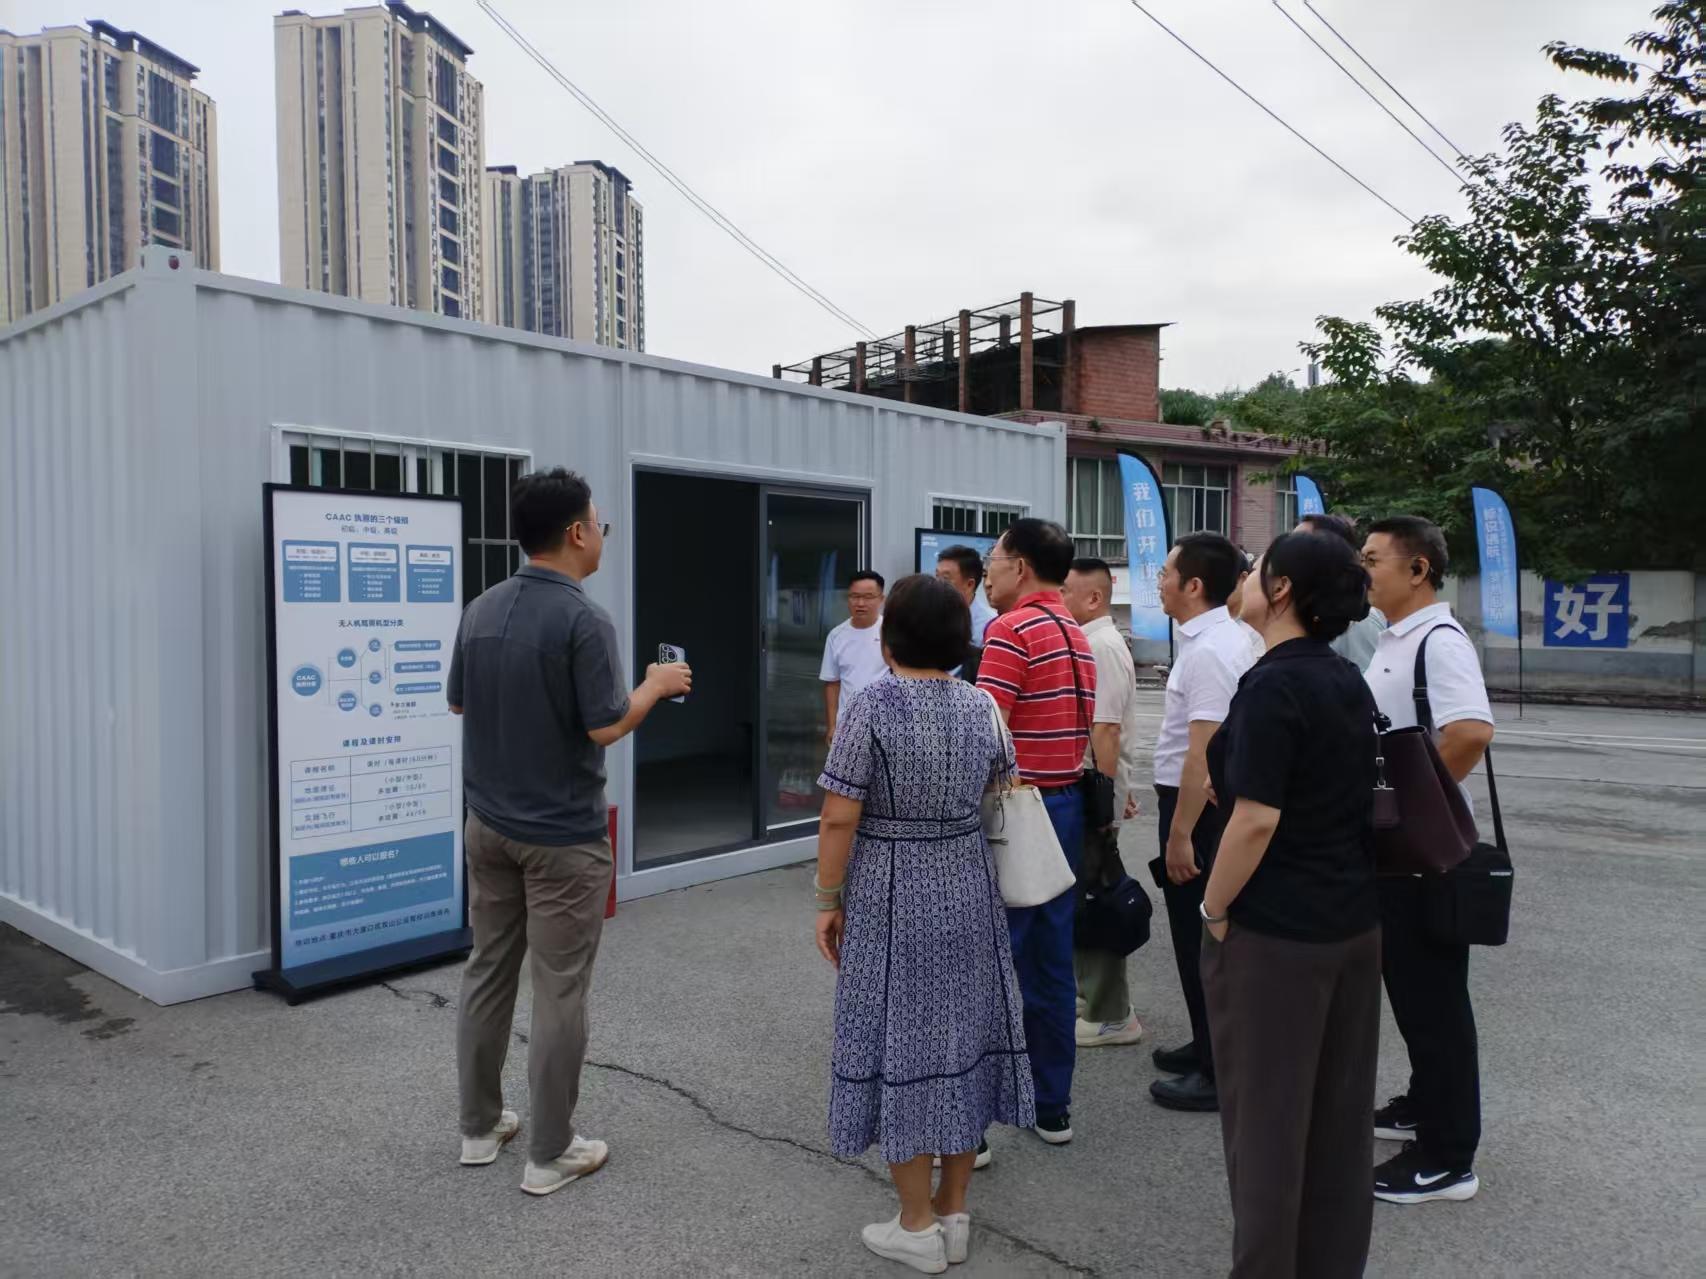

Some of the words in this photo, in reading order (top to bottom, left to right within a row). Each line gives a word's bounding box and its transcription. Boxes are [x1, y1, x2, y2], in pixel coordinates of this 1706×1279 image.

[325, 513, 352, 521] CAAC
[1553, 583, 1624, 641] 好
[342, 735, 402, 747] 课程及课时安排
